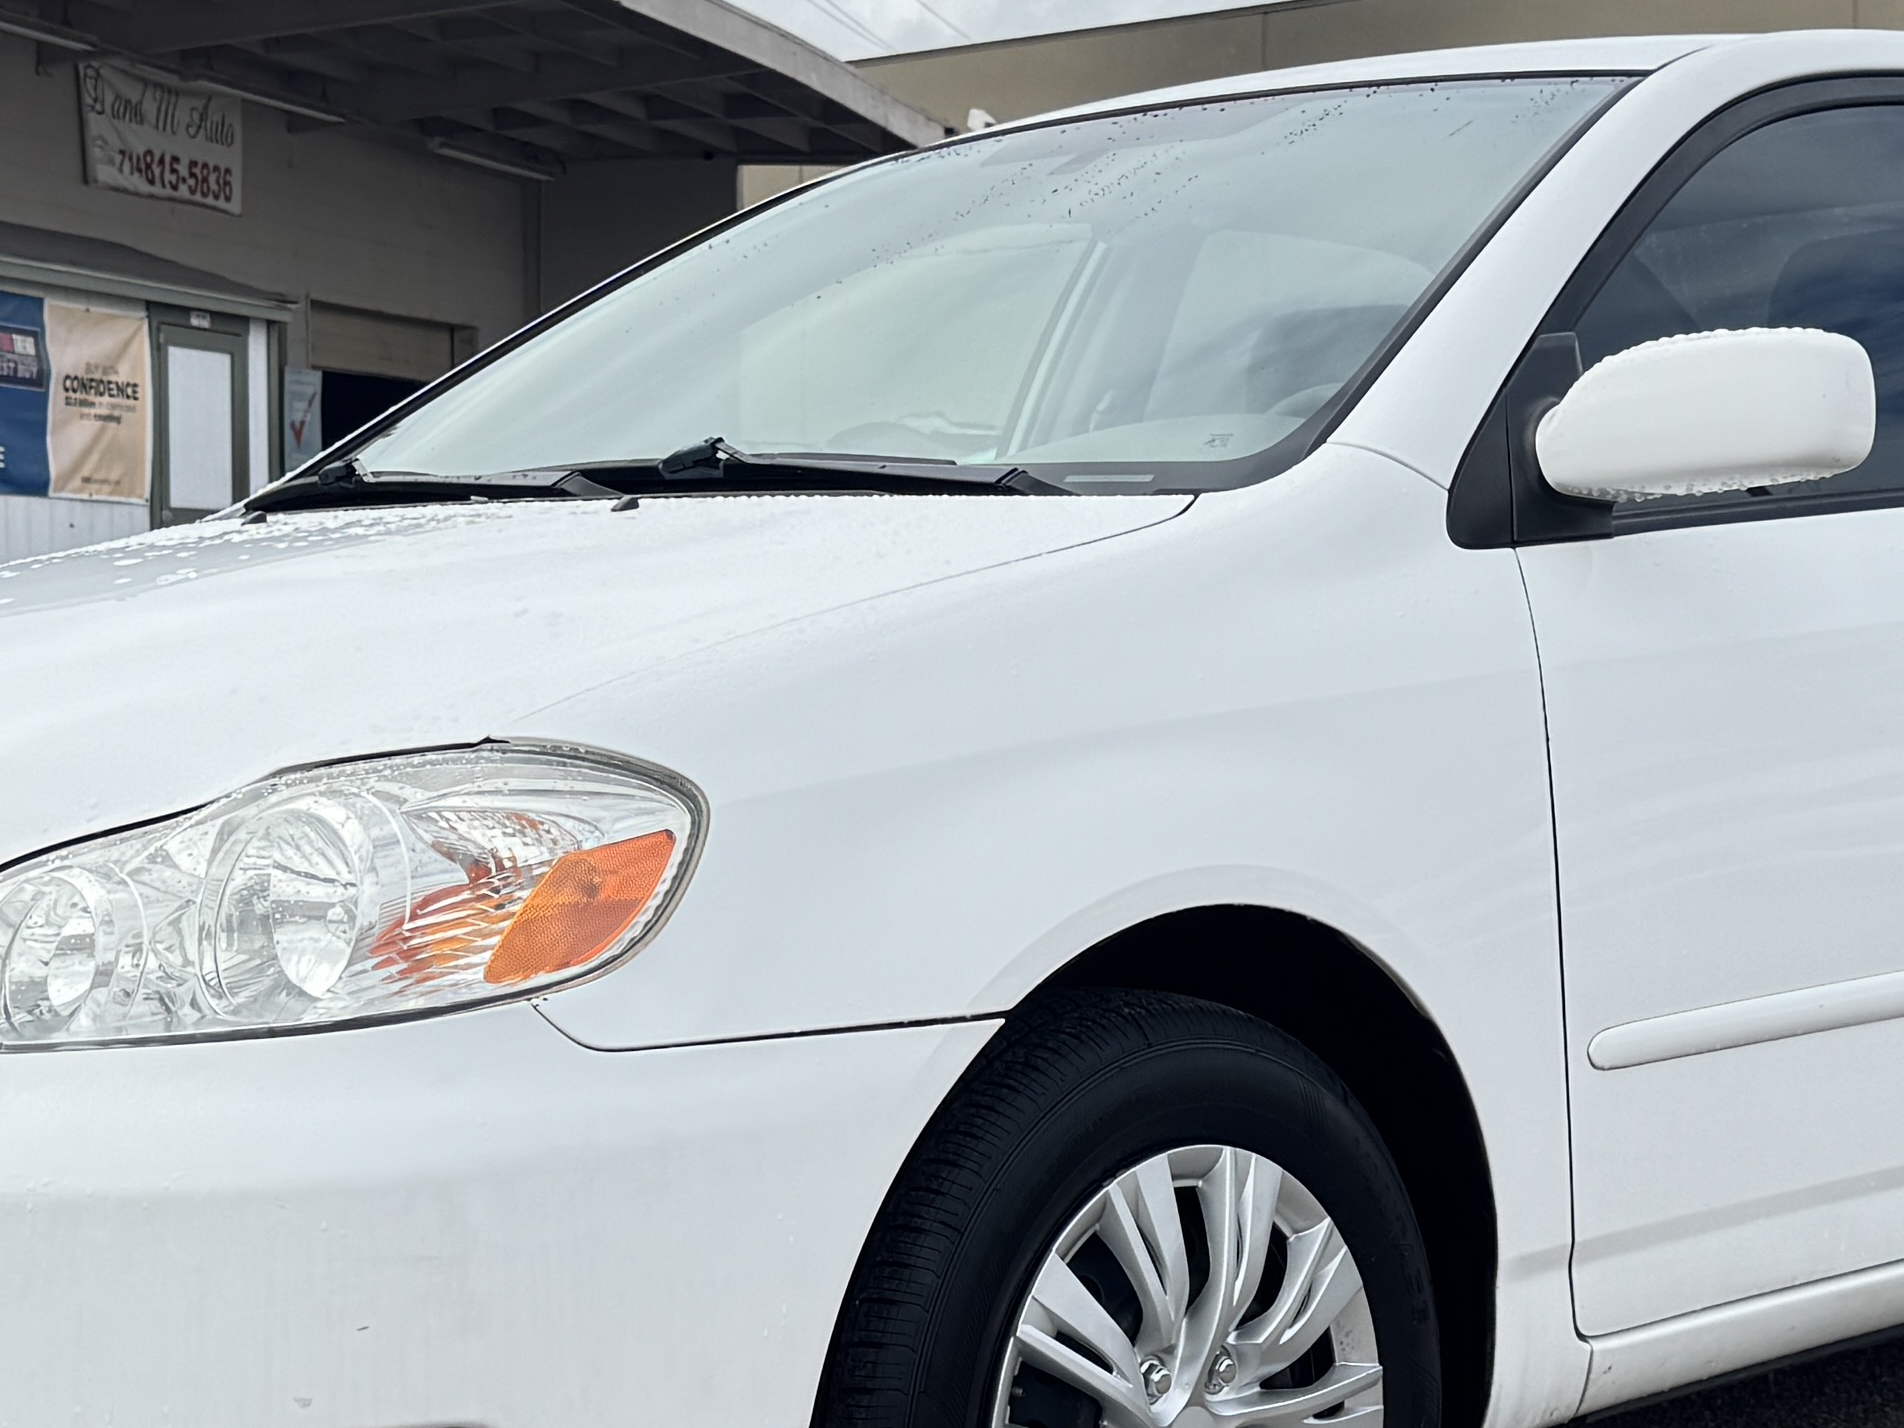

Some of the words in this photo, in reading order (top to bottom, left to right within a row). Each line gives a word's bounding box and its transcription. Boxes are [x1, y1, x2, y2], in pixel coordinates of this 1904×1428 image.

[110, 81, 148, 126] and
[152, 82, 180, 136] M
[185, 95, 235, 148] Auto
[62, 374, 140, 401] CONFIDENCE
